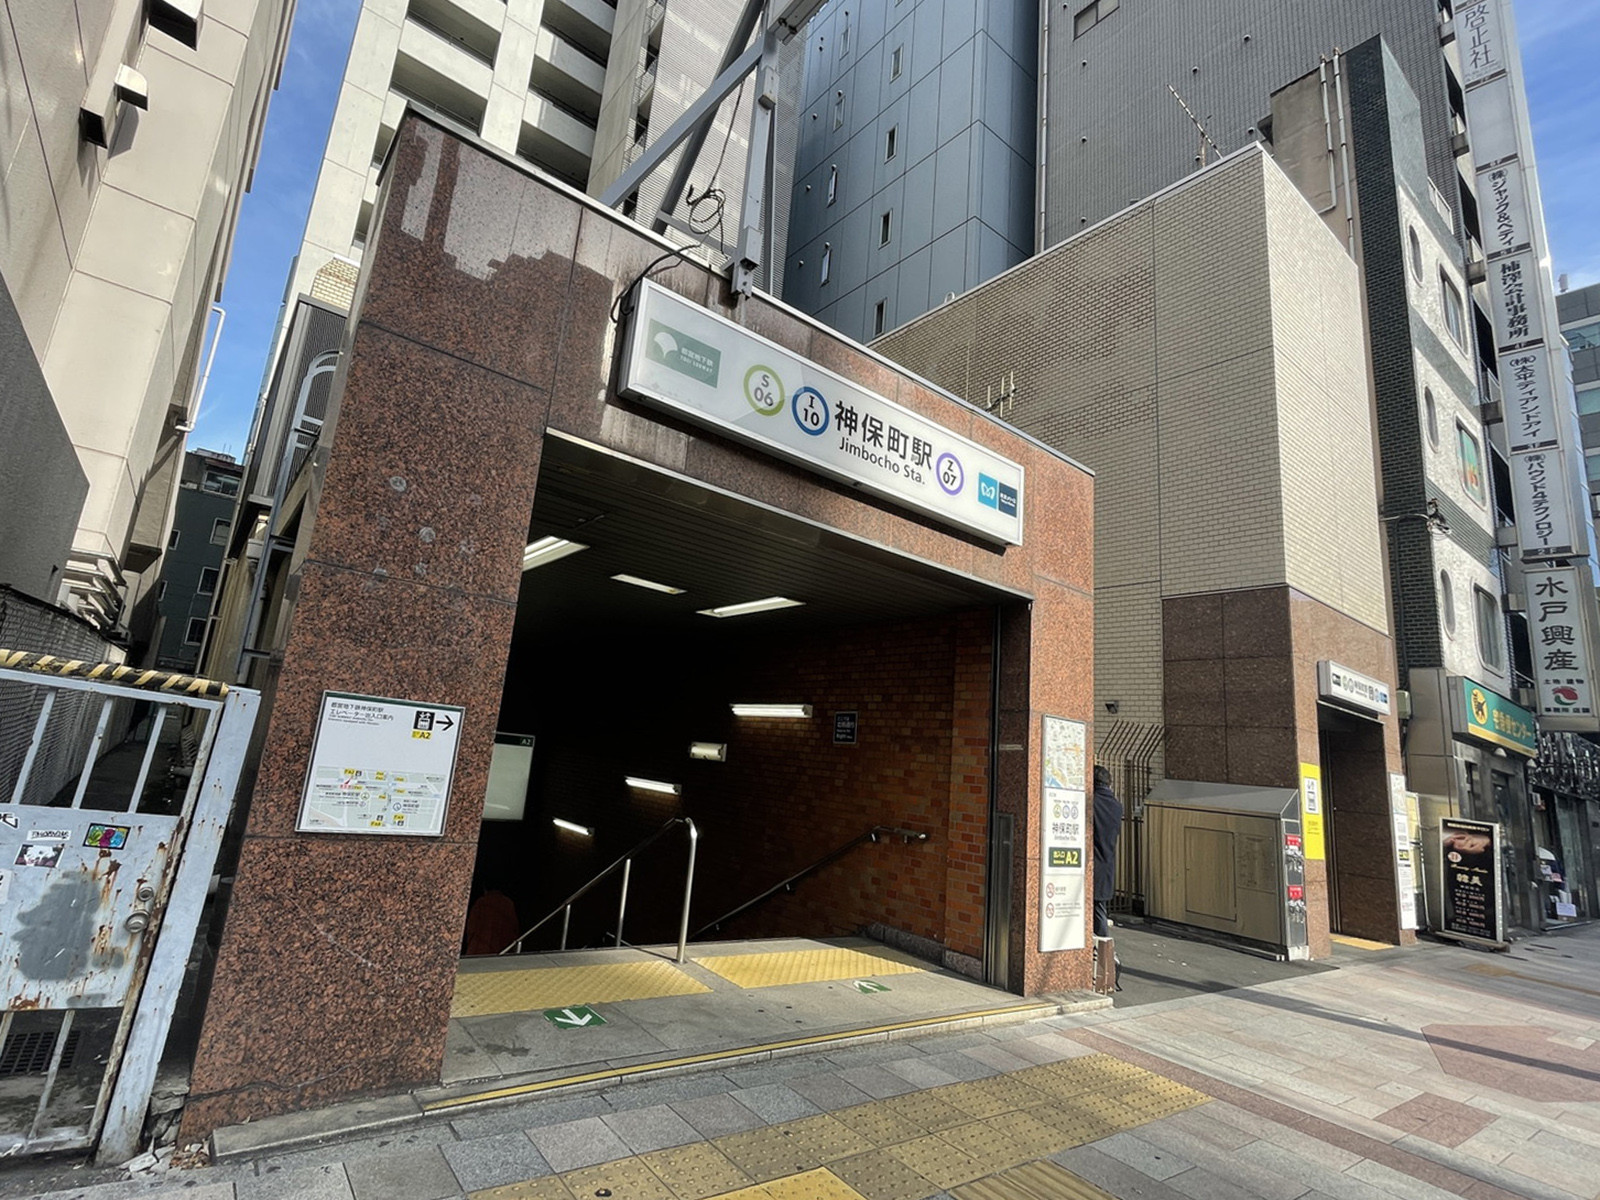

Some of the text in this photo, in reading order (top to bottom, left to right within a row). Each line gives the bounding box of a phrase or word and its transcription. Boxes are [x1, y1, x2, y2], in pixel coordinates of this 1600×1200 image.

[761, 374, 770, 388] S
[754, 387, 774, 407] 06
[803, 408, 820, 426] 10
[834, 400, 933, 471] 神保町駅
[839, 436, 925, 485] Jimbocho Sta.
[947, 460, 954, 472] Z
[942, 471, 957, 486] 07
[1534, 576, 1579, 671] 水戸興産
[1065, 851, 1079, 865] A2
